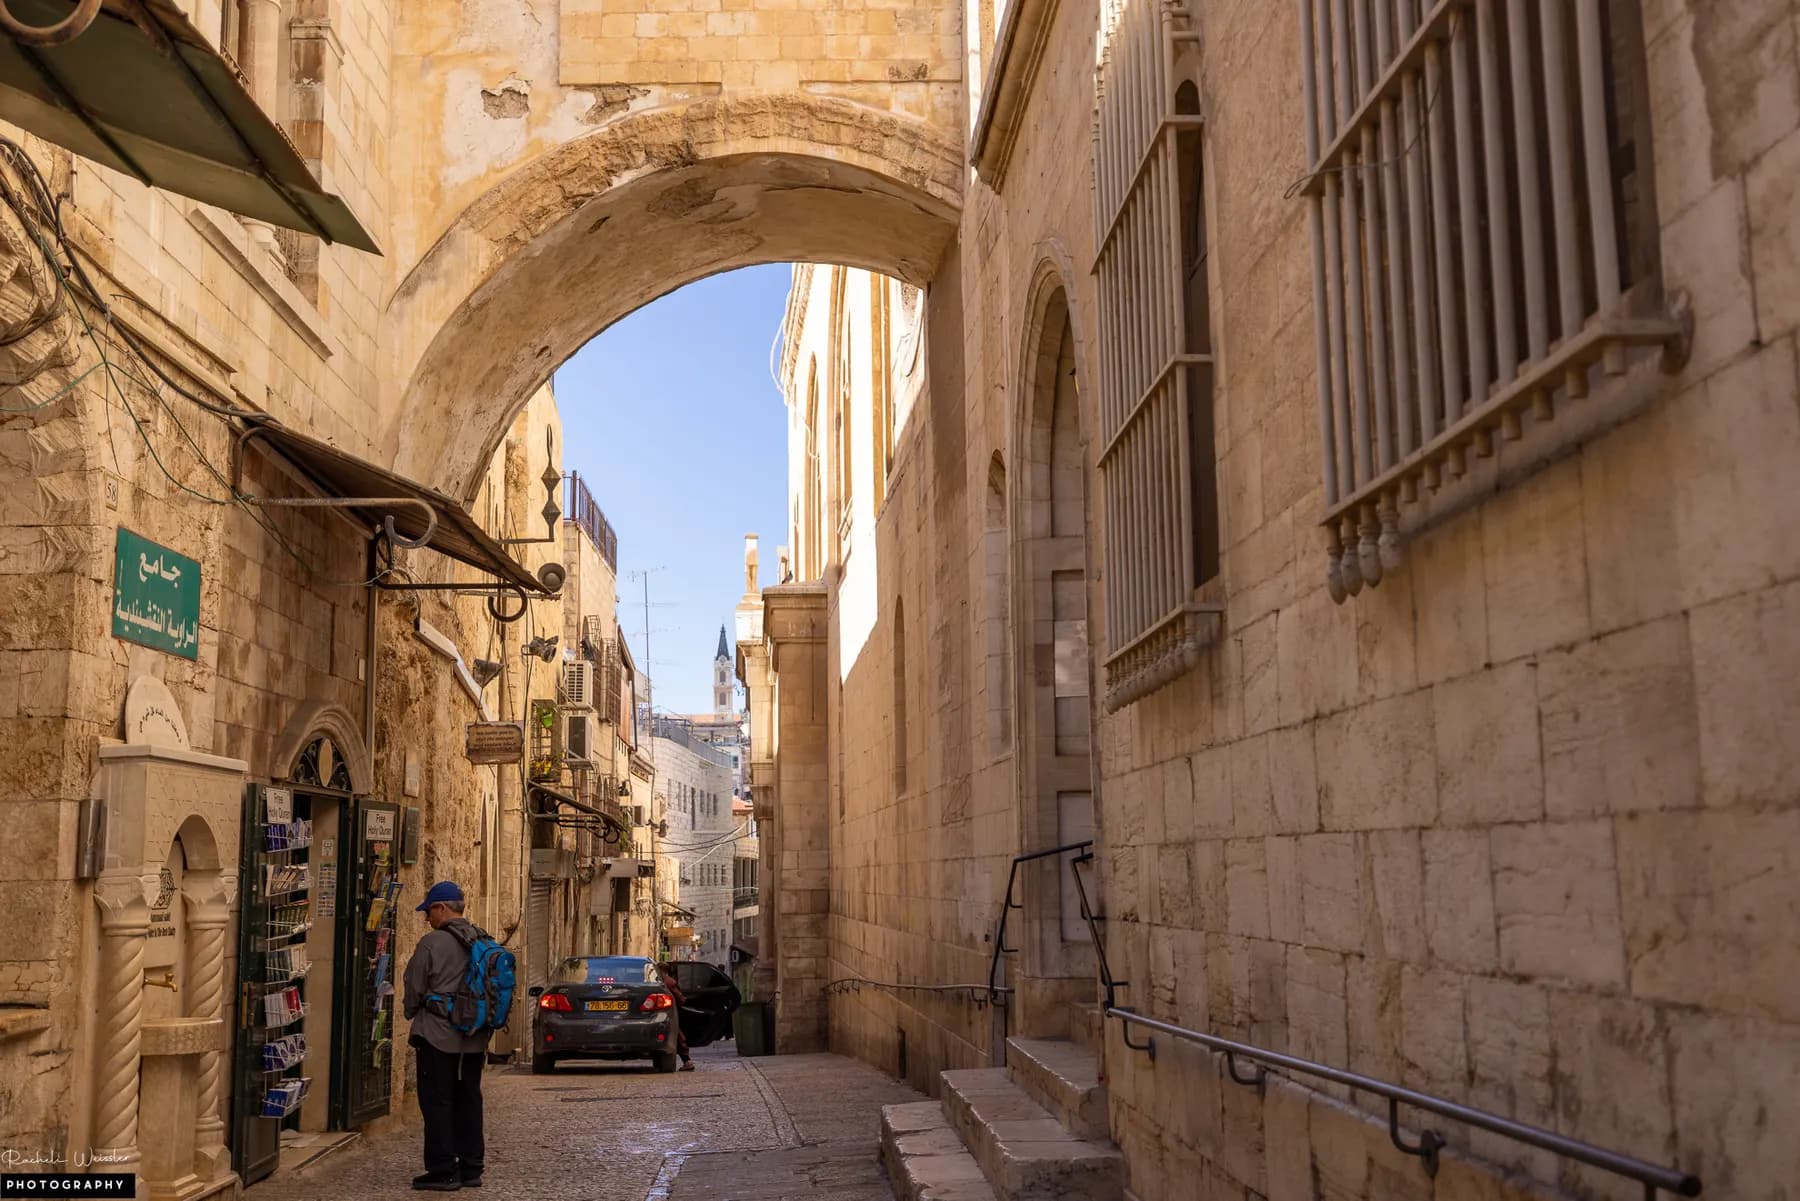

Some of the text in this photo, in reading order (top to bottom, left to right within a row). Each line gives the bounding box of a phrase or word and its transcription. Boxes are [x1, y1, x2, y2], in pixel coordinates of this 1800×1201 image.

[106, 482, 117, 502] 58
[138, 552, 181, 588] جامع
[273, 792, 284, 804] Free
[376, 813, 386, 824] Free
